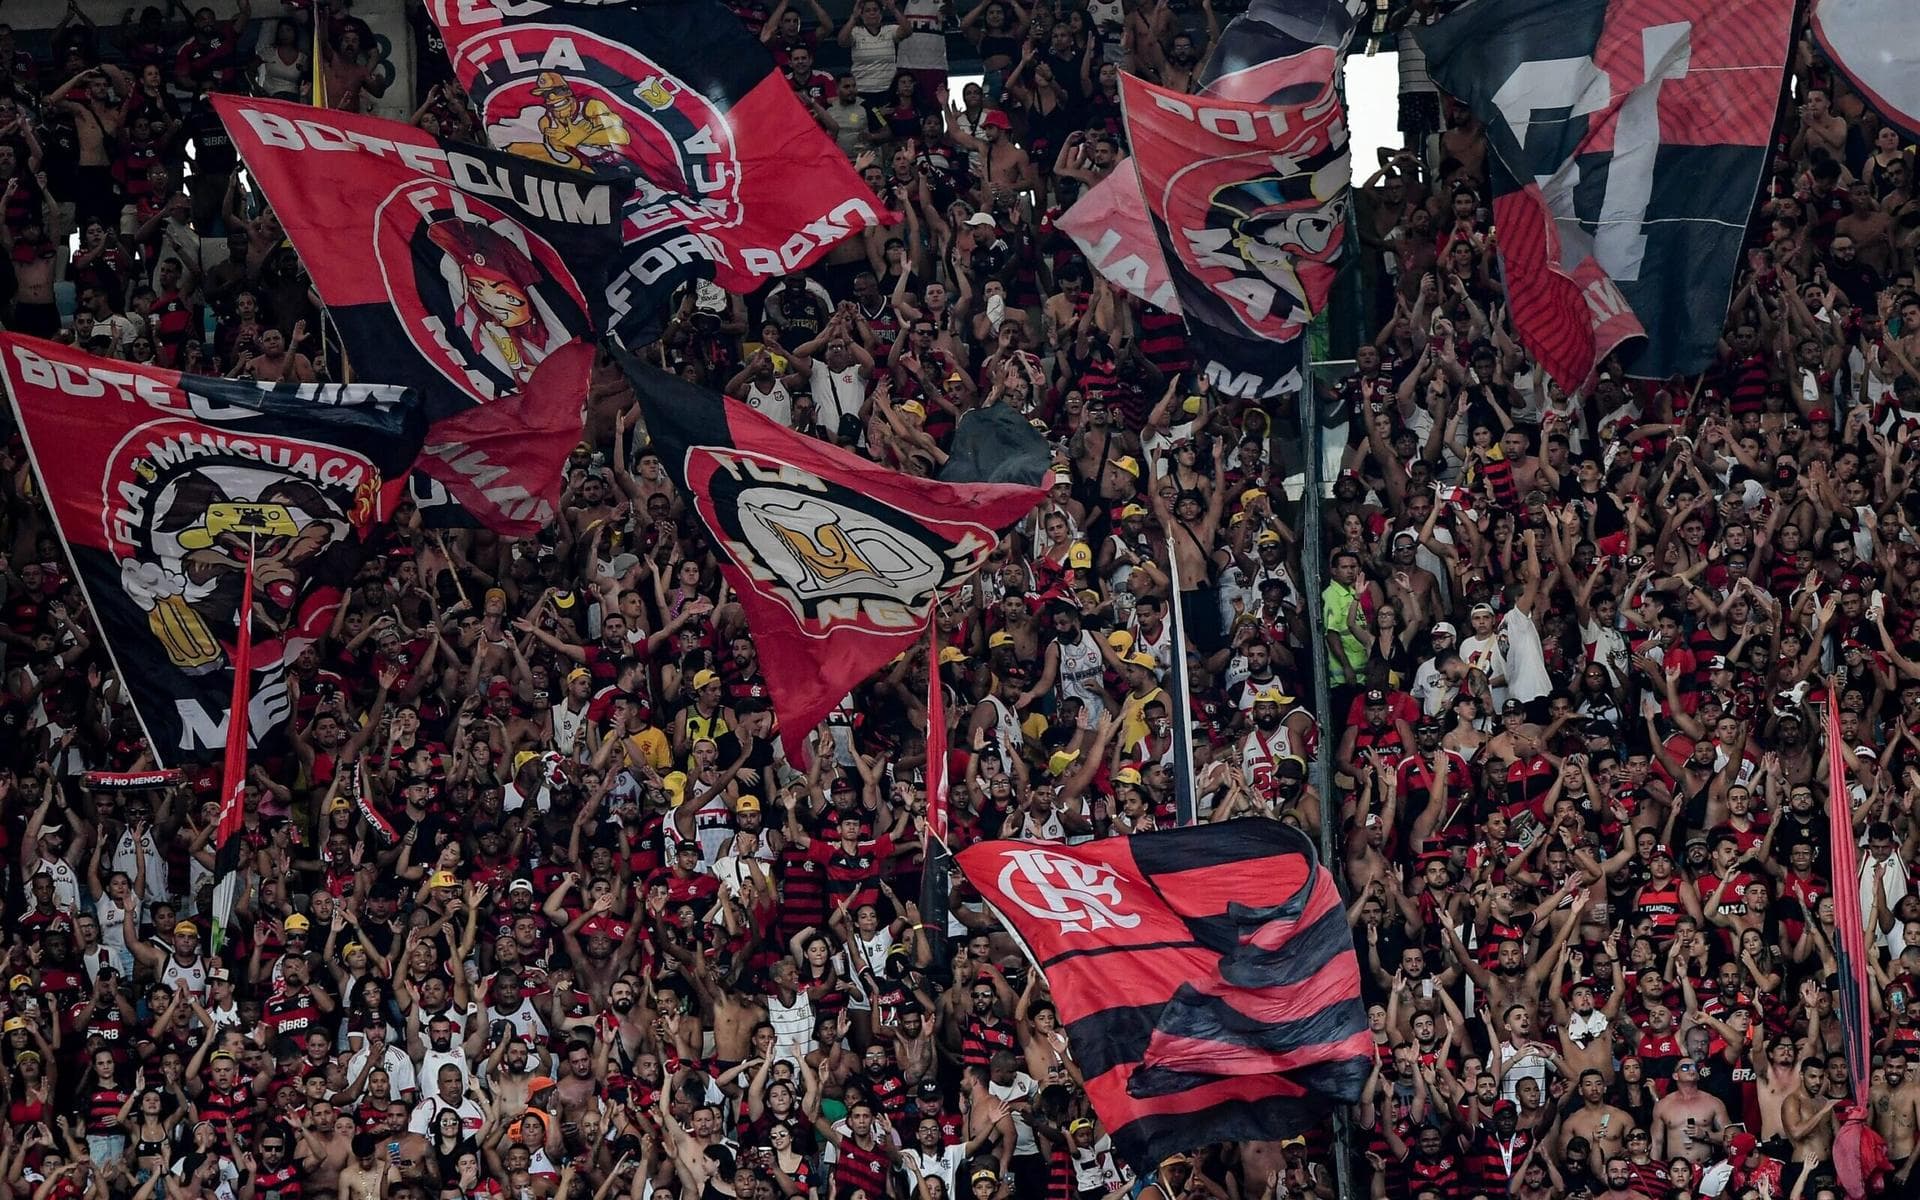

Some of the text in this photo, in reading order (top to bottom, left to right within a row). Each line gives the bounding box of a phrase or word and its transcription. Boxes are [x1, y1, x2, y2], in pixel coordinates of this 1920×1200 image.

[466, 36, 585, 86] FLA
[115, 480, 148, 549] FLA
[145, 430, 365, 494] MANGUAÇA
[113, 777, 129, 786] NO
[130, 775, 165, 786] MENGO
[1717, 903, 1747, 915] AIXA
